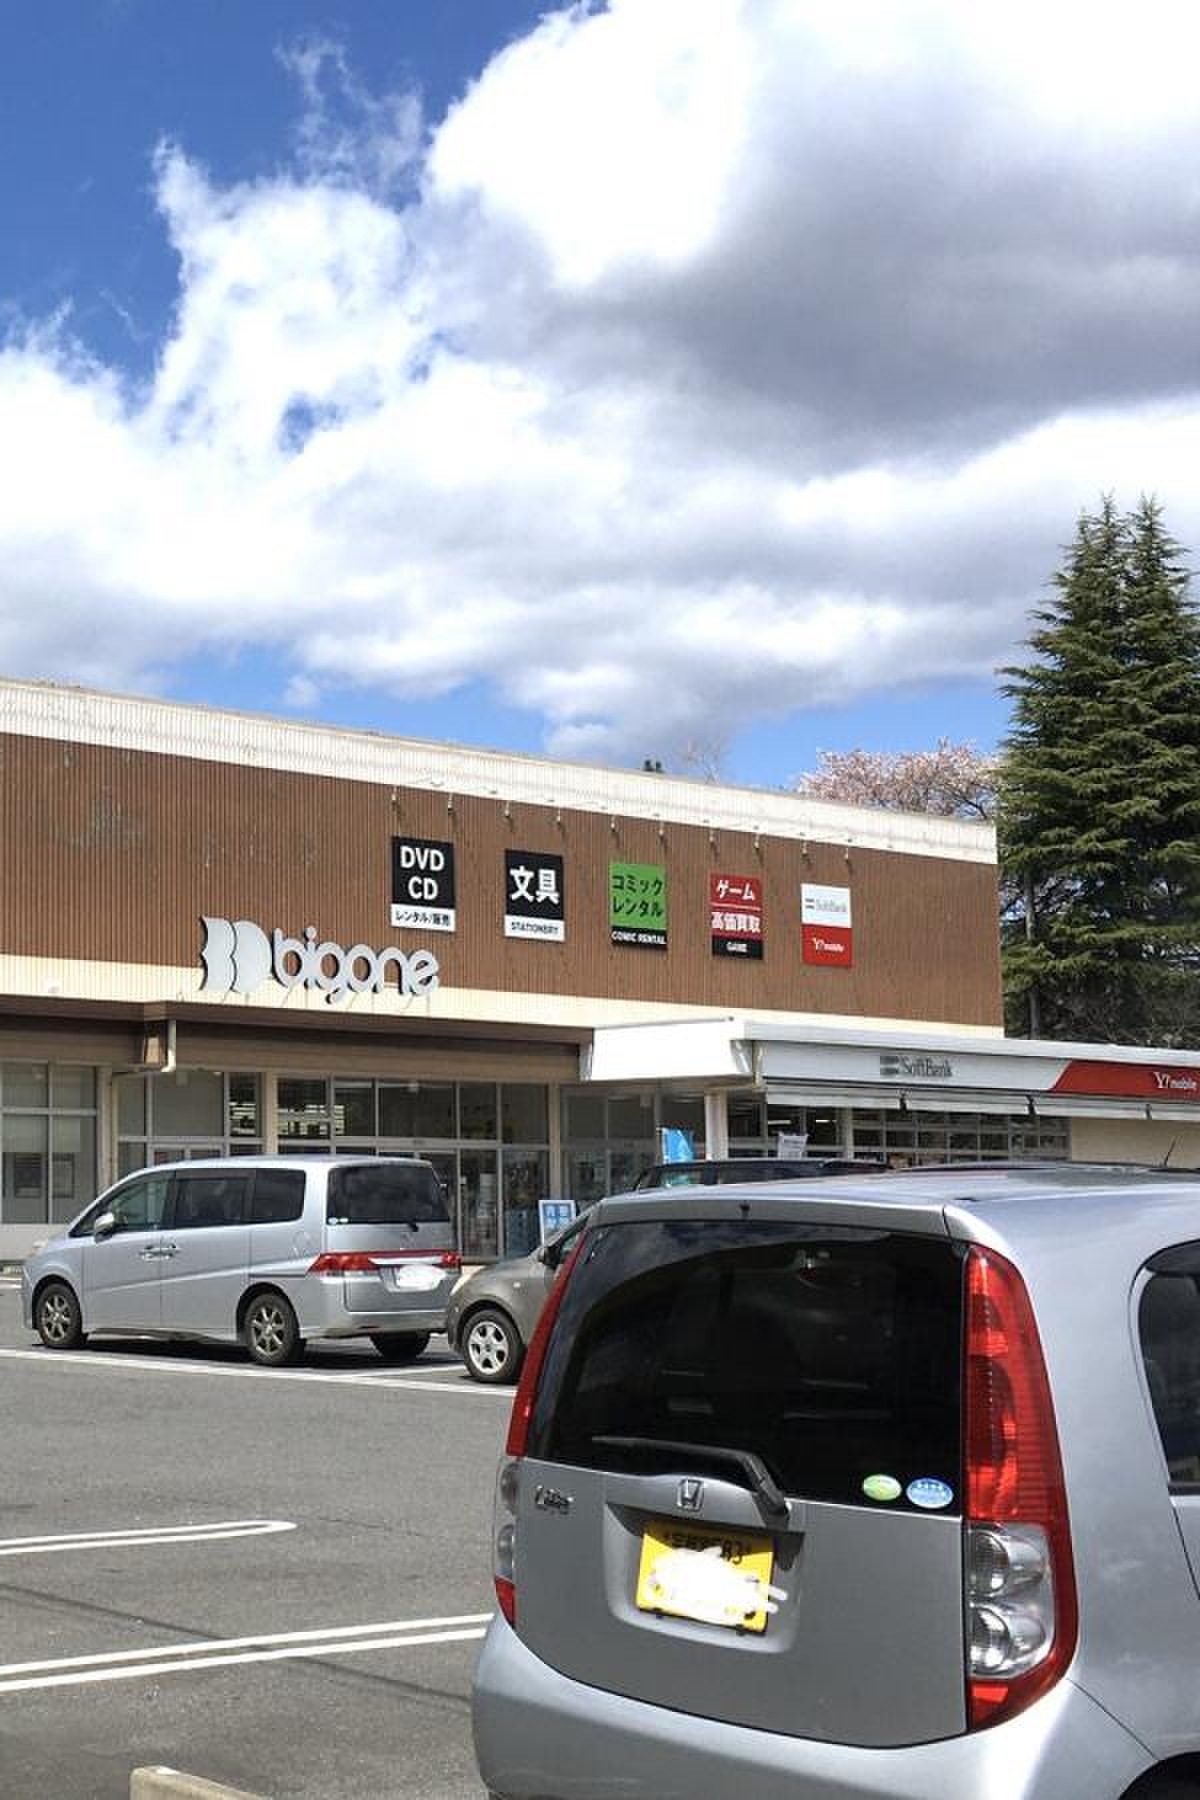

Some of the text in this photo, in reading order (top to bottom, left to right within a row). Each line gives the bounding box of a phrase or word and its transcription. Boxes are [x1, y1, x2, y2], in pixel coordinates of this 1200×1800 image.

[400, 845, 446, 872] DVD
[407, 875, 439, 901] CD
[509, 865, 560, 905] 文具
[612, 874, 664, 897] コミック
[716, 879, 756, 900] ゲーム
[613, 896, 665, 918] レンタル
[272, 925, 440, 1004] bigone
